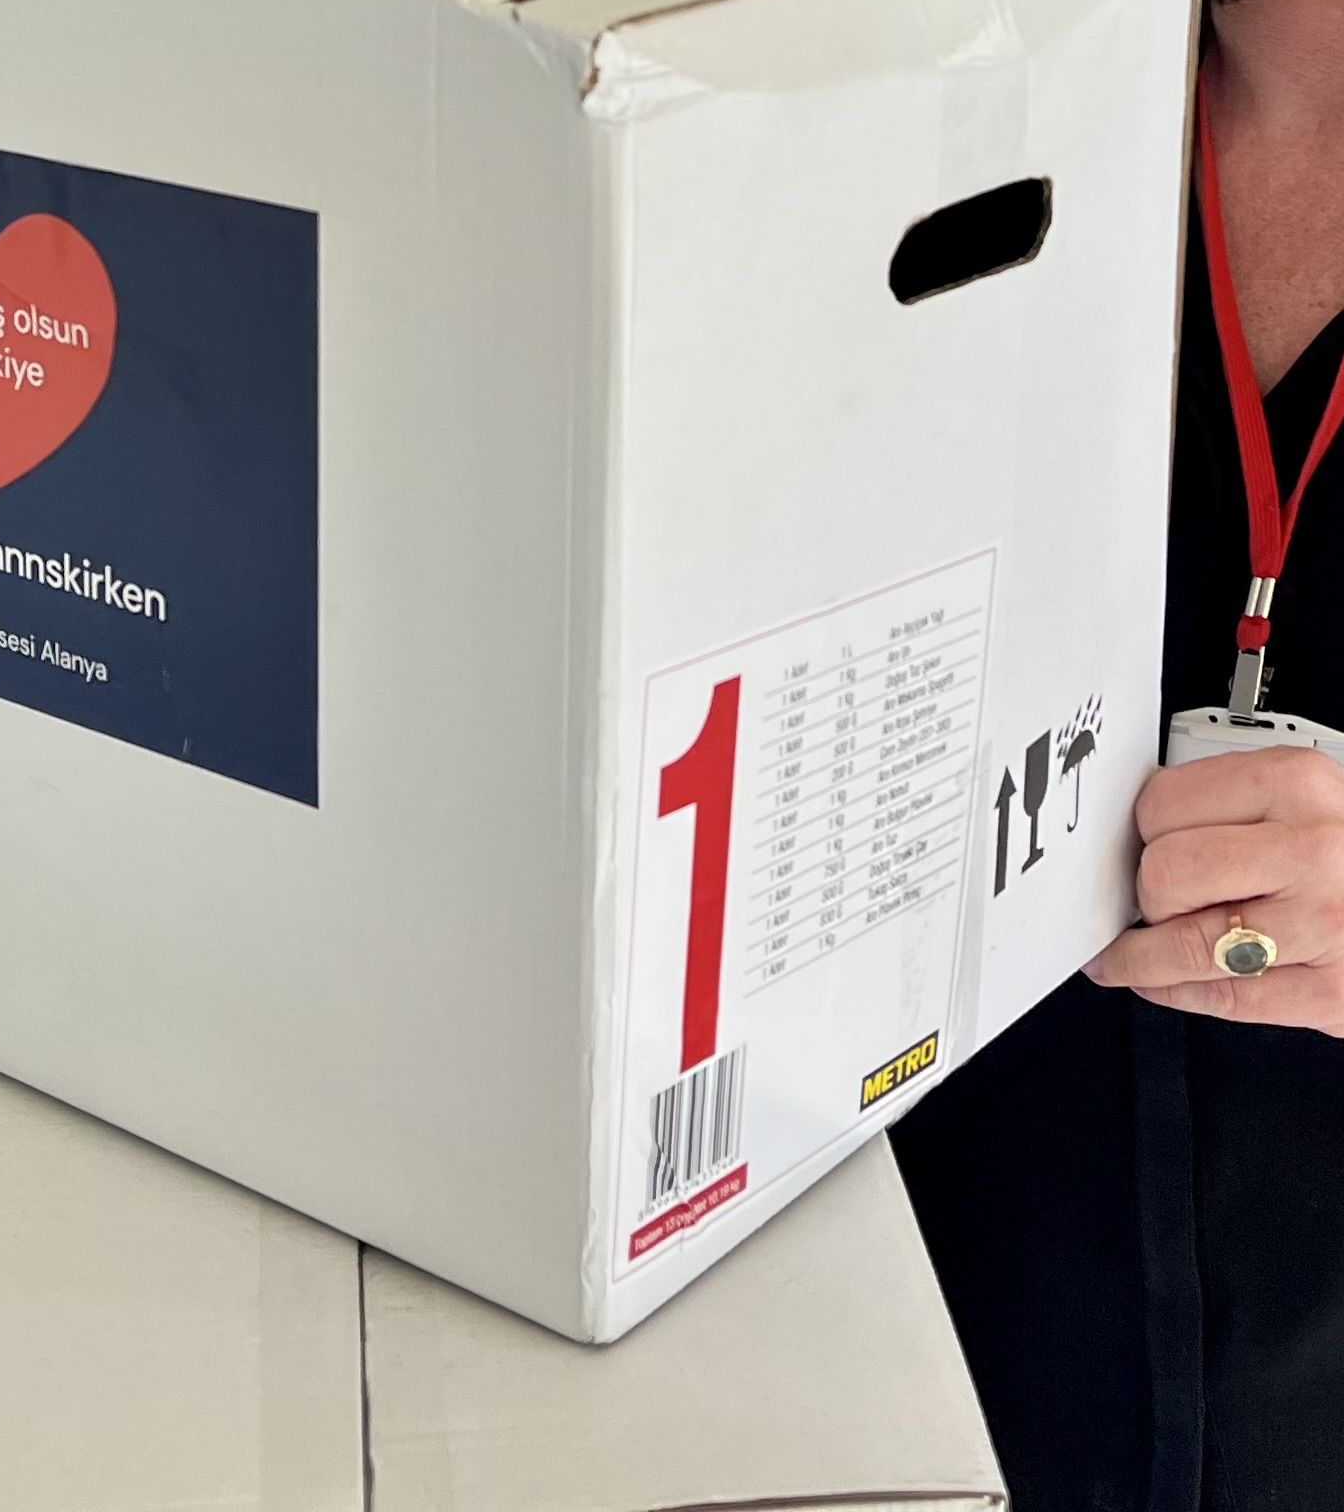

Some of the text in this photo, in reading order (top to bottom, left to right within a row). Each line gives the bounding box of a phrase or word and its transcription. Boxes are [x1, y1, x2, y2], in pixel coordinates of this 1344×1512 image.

[13, 303, 89, 349] olsun
[40, 641, 108, 683] Alanya
[658, 673, 742, 1075] 1
[862, 1033, 936, 1107] METRO
